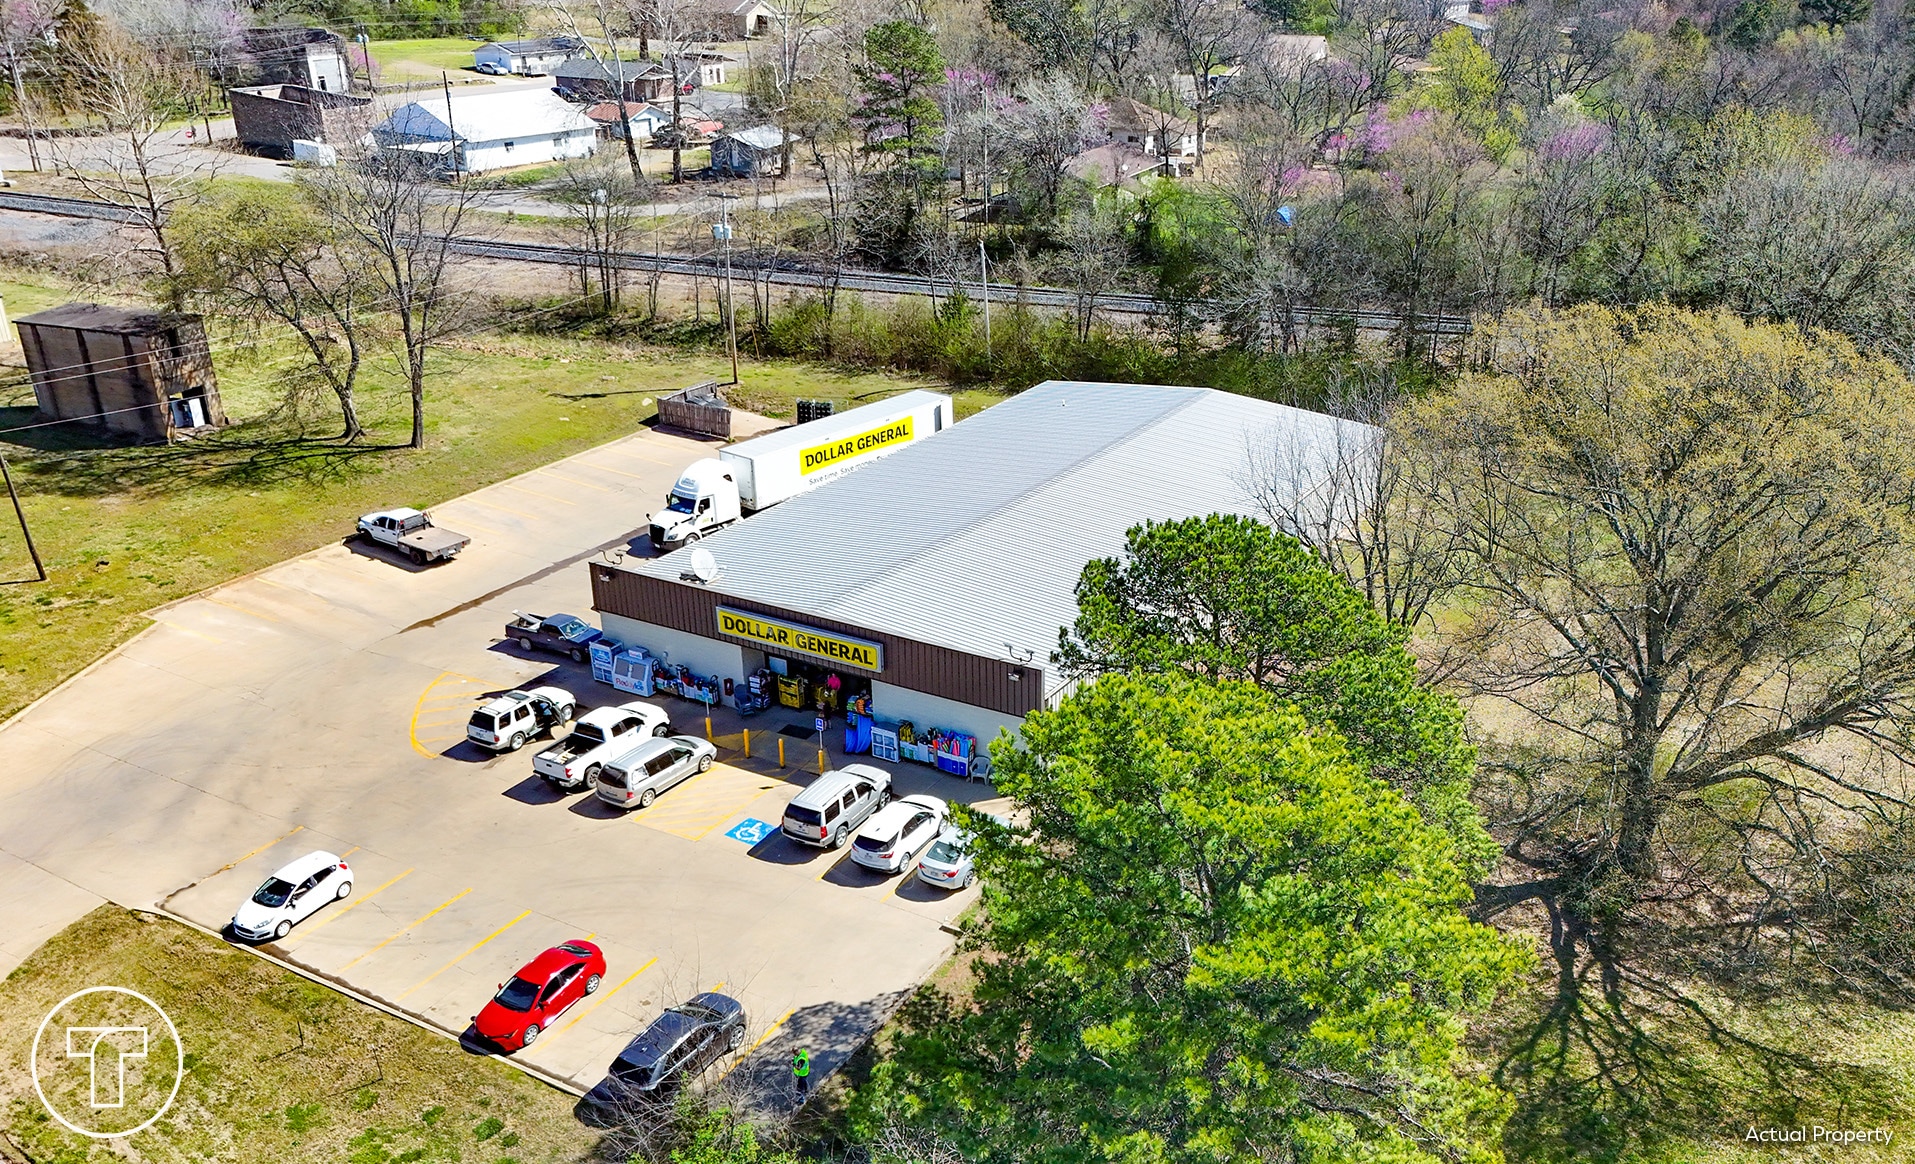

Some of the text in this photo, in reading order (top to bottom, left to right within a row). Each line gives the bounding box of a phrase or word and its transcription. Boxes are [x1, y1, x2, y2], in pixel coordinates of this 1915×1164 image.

[805, 424, 909, 467] DOLLAR GENERAL
[722, 615, 874, 665] DOLLAR GENERAL
